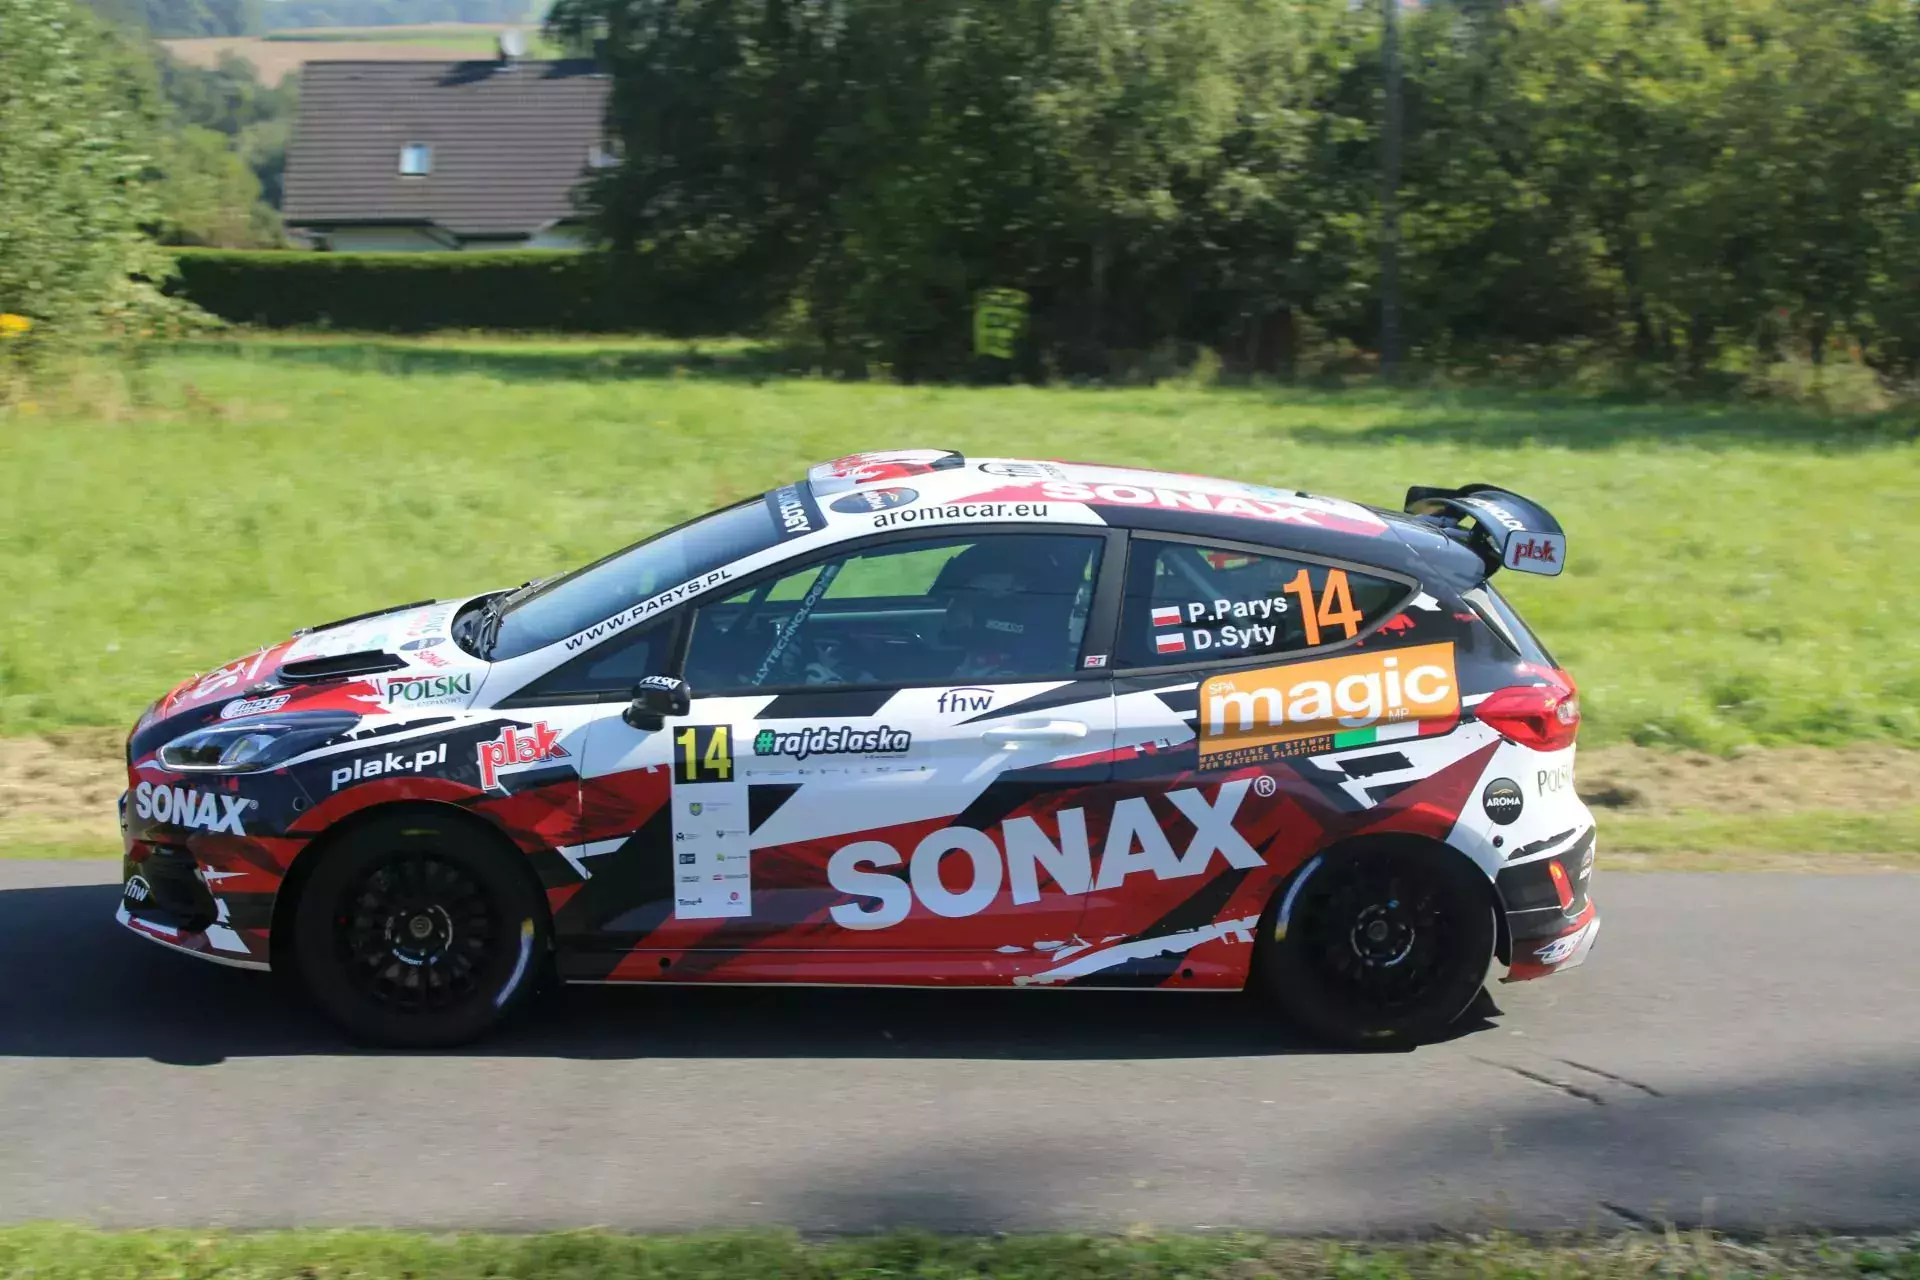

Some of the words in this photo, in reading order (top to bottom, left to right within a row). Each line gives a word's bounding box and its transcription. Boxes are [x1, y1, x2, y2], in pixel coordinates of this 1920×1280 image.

[873, 501, 1048, 528] aromacar.eu
[1042, 481, 1321, 526] SONAX
[1512, 538, 1556, 566] plak
[565, 570, 732, 650] WWW.PARYS.PL
[1188, 596, 1288, 623] P.Parys
[1283, 568, 1364, 645] 14
[1192, 624, 1277, 650] D.Syty
[1086, 656, 1105, 667] RT
[388, 673, 472, 704] POLSKI
[937, 691, 992, 713] fhw
[1208, 681, 1235, 695] SPA
[1208, 657, 1450, 736] magic
[1388, 707, 1410, 722] MP
[677, 726, 732, 780] 14
[755, 725, 910, 759] #rajdslaska
[1199, 746, 1264, 764] MACCHINE
[1272, 743, 1279, 752] E
[1285, 736, 1332, 751] STAMPI
[331, 743, 447, 791] plak.pl
[478, 722, 571, 791] plak
[1199, 761, 1219, 770] PER
[1224, 754, 1269, 767] MATERIE
[1274, 744, 1332, 760] PLASTICHE
[1486, 796, 1521, 807] AROMA
[124, 879, 149, 902] fhw
